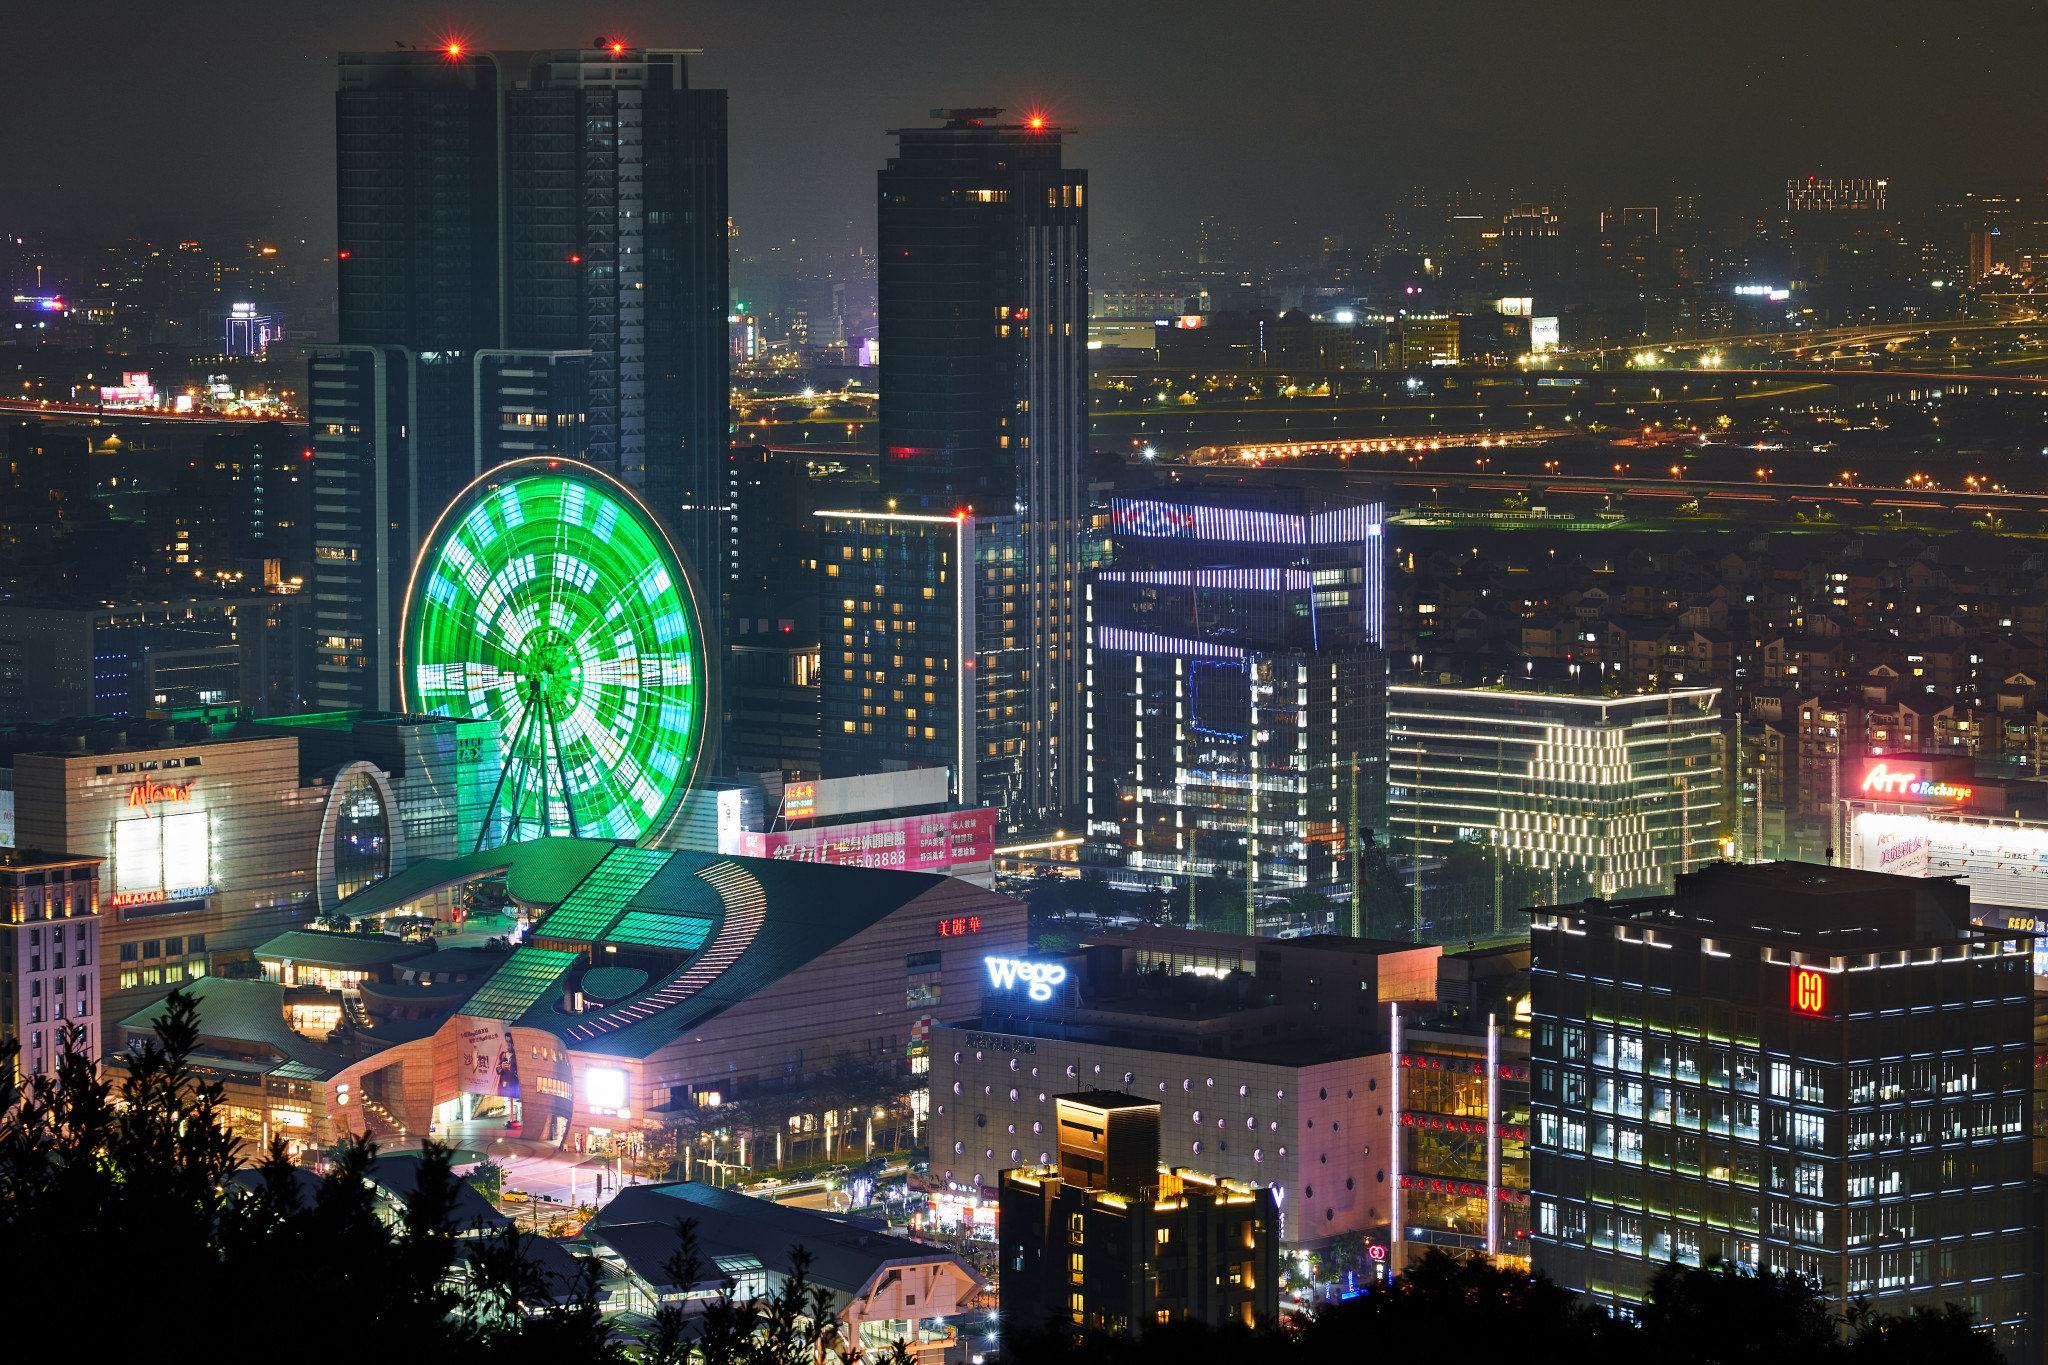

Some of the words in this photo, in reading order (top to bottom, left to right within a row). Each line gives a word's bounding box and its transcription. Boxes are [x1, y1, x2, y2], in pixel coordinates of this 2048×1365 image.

[1862, 763, 1916, 793] ATT
[1919, 781, 1972, 801] Recharge
[112, 891, 164, 906] MIRAMAR
[170, 885, 215, 899] CINEMAS
[938, 916, 981, 936] 美麗華
[2008, 917, 2034, 931] REBO
[984, 957, 1066, 1001] Wego
